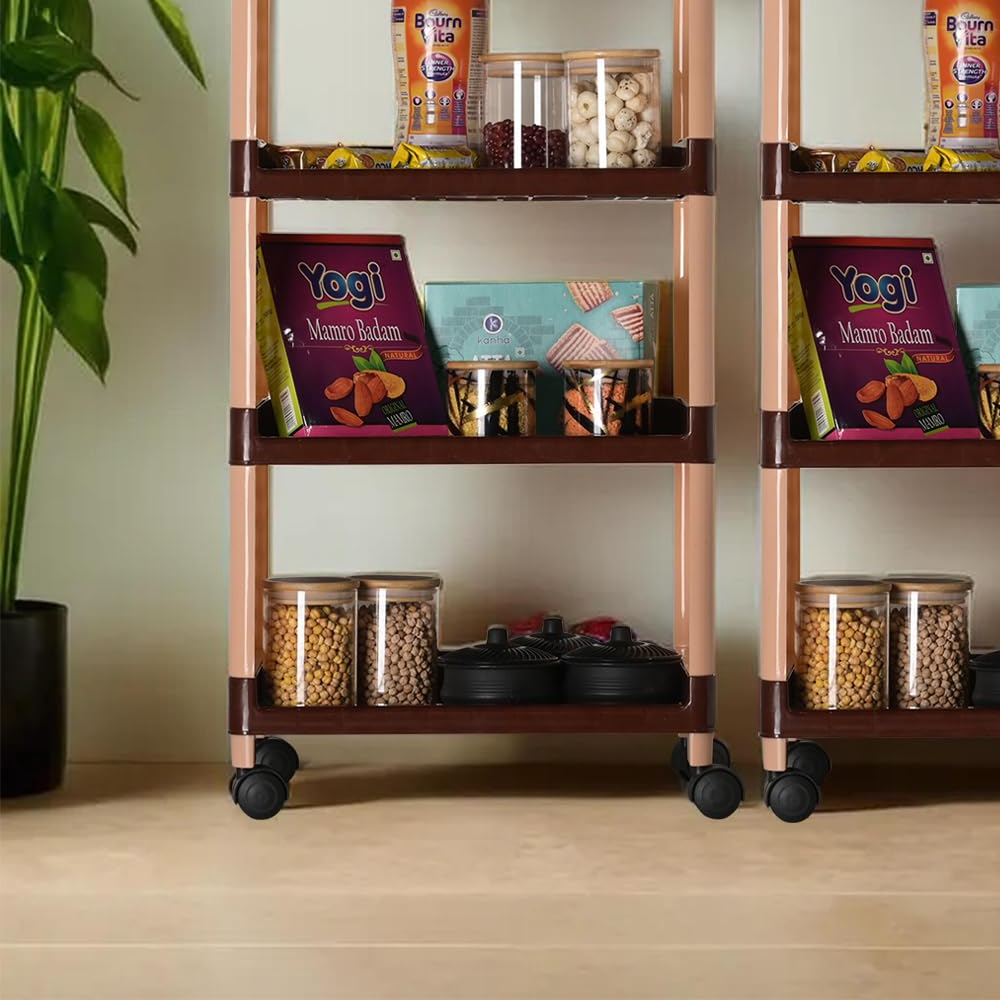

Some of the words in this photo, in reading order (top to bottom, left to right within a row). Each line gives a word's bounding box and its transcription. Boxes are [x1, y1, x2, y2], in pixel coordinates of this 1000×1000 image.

[297, 261, 387, 311] Yogi
[829, 264, 919, 314] Yogi
[306, 318, 355, 341] Mamro
[355, 317, 402, 342] Badam
[838, 321, 887, 344] Mamro
[887, 320, 934, 345] Badam
